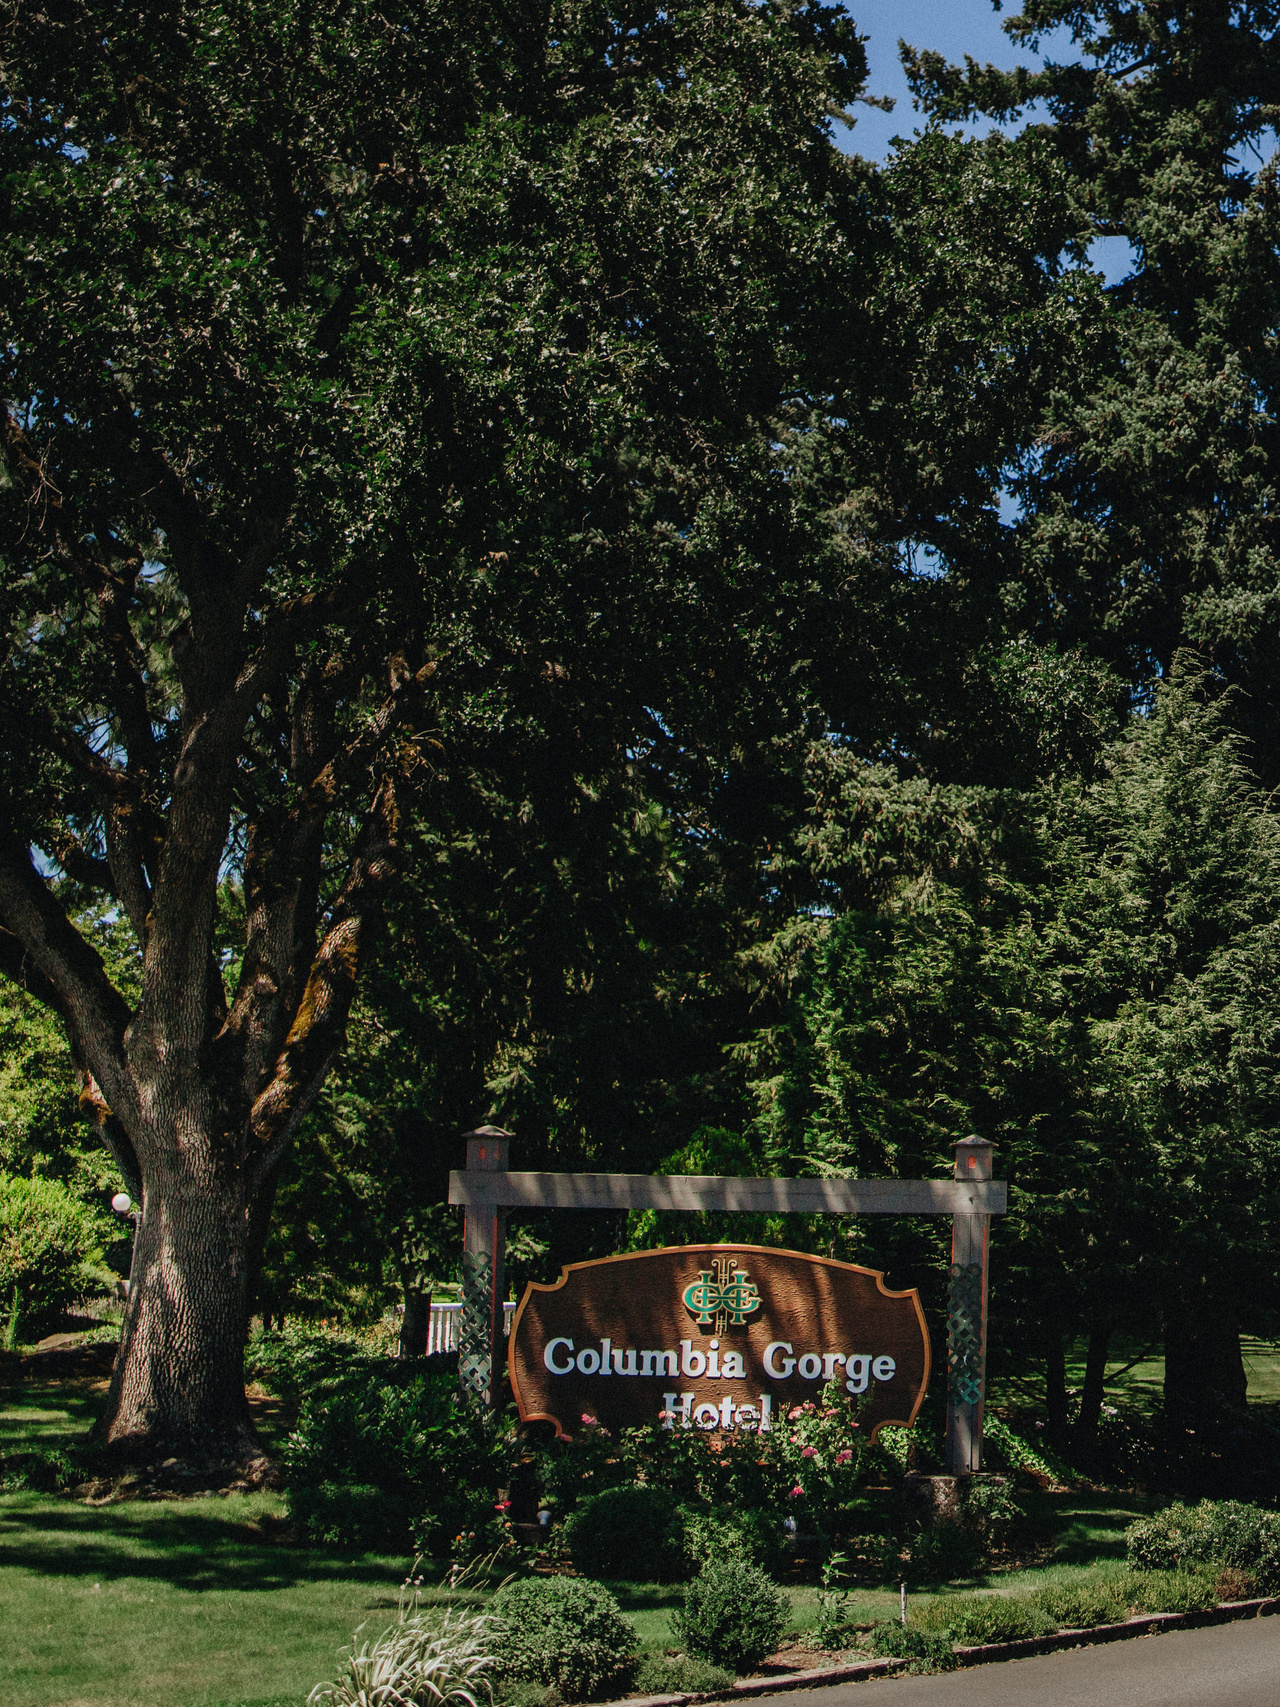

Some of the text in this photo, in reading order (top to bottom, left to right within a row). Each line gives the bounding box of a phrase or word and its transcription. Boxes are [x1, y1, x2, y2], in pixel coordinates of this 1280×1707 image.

[543, 1337, 896, 1394] Columbia Gorge
[662, 1392, 774, 1432] Hotel
